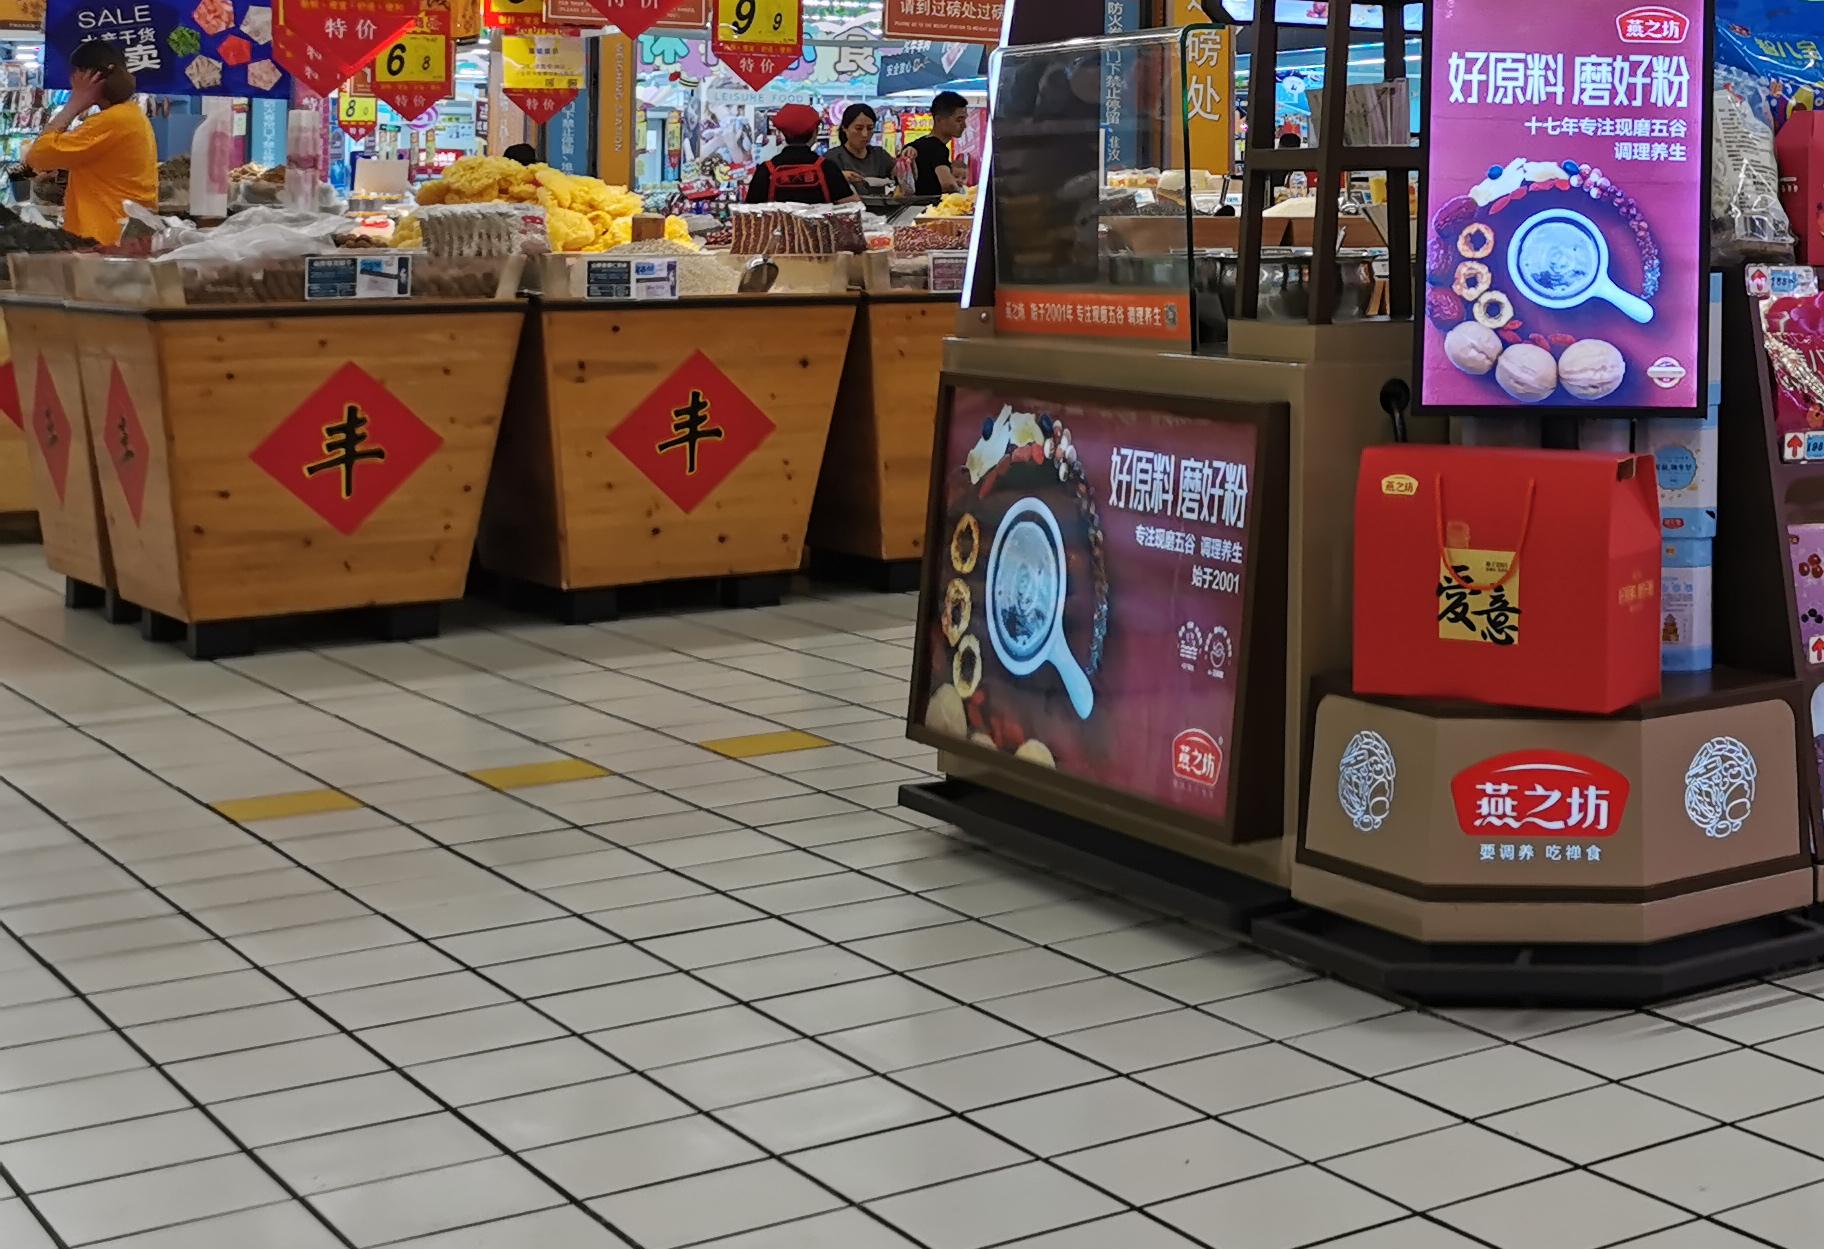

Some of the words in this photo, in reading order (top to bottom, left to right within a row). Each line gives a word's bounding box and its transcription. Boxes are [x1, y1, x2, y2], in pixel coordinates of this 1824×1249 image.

[78, 4, 152, 29] SALE
[325, 19, 378, 40] 特价
[1626, 19, 1681, 40] 燕之坊
[738, 55, 776, 74] 特价
[1447, 52, 1564, 106] 好原料
[1572, 54, 1690, 108] 磨好粉
[395, 95, 426, 108] 特价
[525, 98, 555, 112] 特价
[714, 91, 765, 103] LEISURE
[772, 93, 805, 104] FOOD
[1524, 116, 1688, 138] 十七年专注现磨五谷
[1614, 142, 1688, 162] 调理养生
[656, 388, 725, 474] 丰
[306, 402, 387, 500] 丰
[1109, 446, 1175, 516] 好原料
[1176, 455, 1249, 528] 磨好粉
[1384, 479, 1416, 494] 燕之坊
[1135, 523, 1196, 556] 专注现磨五谷
[1201, 534, 1243, 565] 调理养生
[1191, 565, 1241, 595] 始于2001
[1436, 565, 1522, 646] 爱意
[1177, 743, 1217, 780] 燕之坊
[1473, 781, 1611, 832] 燕之坊
[1479, 843, 1535, 862] 要调养
[1545, 844, 1603, 863] 吃禅食
